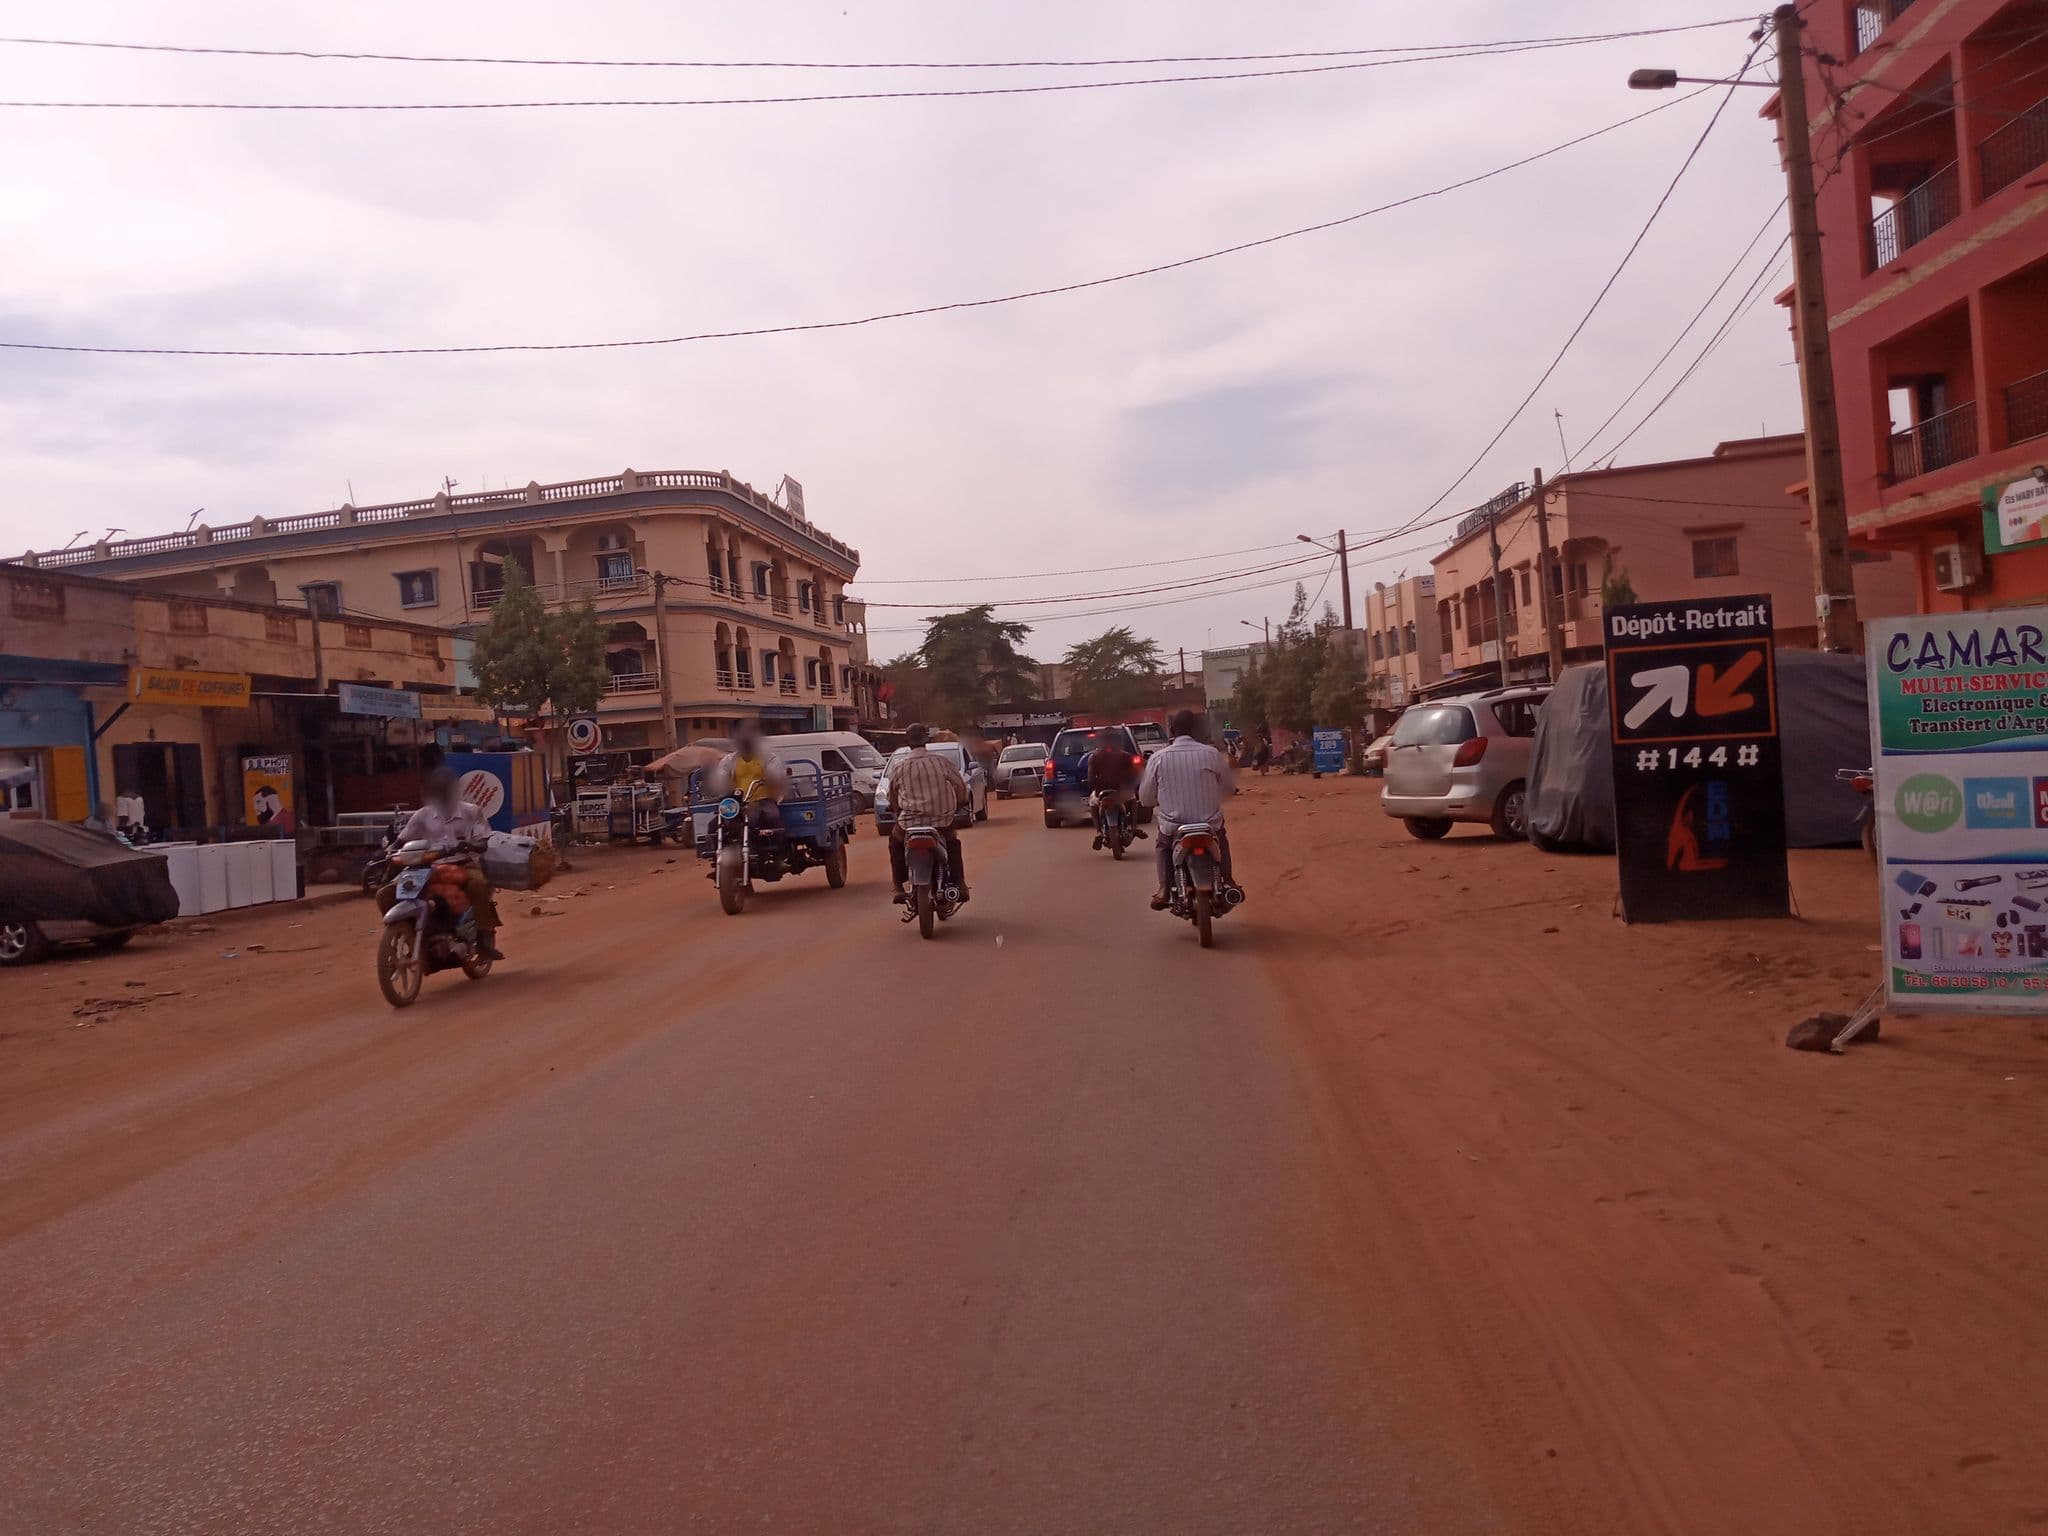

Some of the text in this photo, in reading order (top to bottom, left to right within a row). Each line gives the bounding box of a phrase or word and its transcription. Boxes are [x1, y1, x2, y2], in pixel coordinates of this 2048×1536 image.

[1901, 671, 2048, 694] MULTI-SERVIC
[1922, 696, 2034, 712] Electronique
[1909, 717, 1991, 733] Transfert
[1904, 790, 1954, 817] W@ri
[1932, 976, 1949, 987] 66
[1952, 976, 1969, 987] 30
